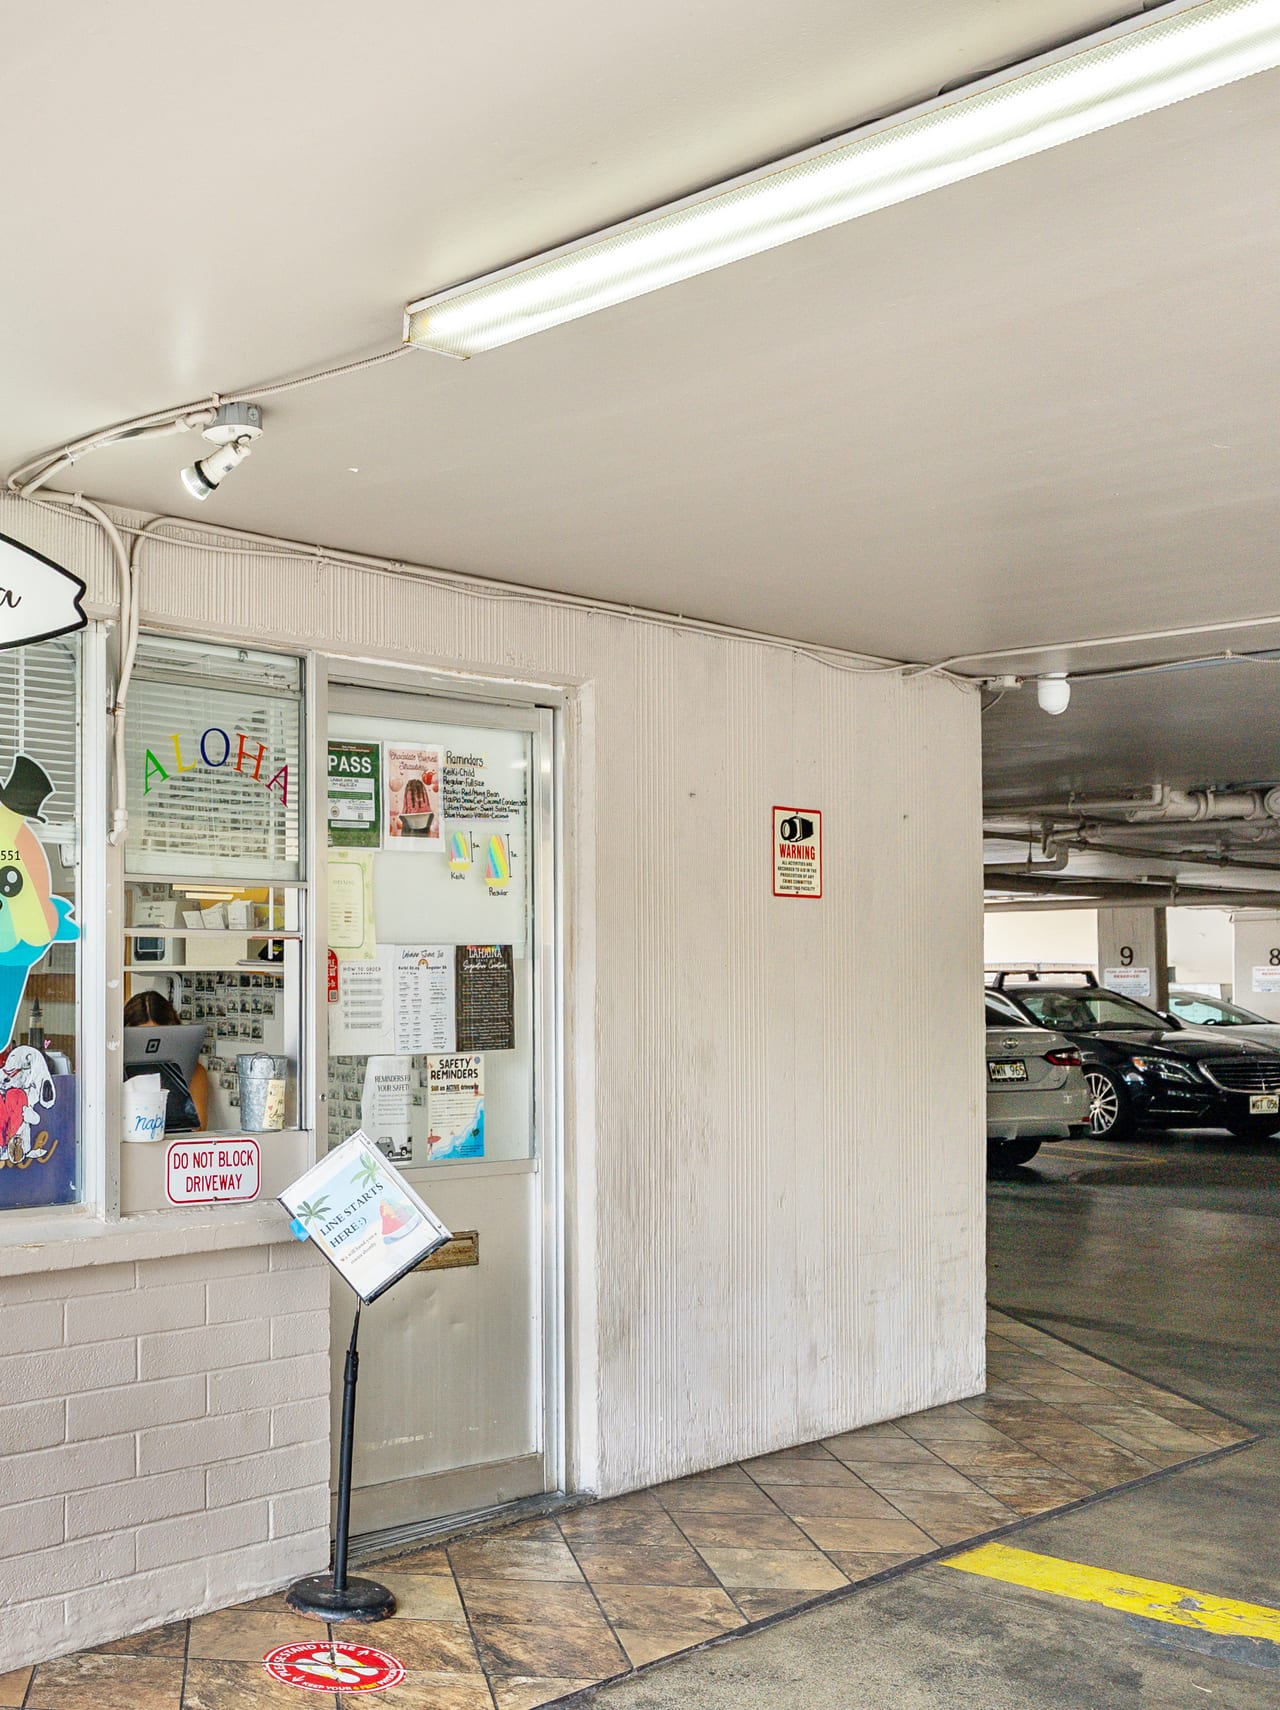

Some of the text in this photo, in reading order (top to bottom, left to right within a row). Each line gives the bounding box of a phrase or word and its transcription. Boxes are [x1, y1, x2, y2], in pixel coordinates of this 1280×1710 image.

[144, 727, 289, 808] ALOHA
[328, 755, 372, 774] PASS
[779, 843, 816, 860] WARNING
[469, 948, 502, 958] LAHAINA
[1120, 946, 1134, 967] 9
[1269, 948, 1280, 967] 8
[440, 1058, 471, 1069] SAFETY
[375, 1074, 404, 1083] REMINDERS
[431, 1069, 478, 1080] REMINDERS
[377, 1084, 392, 1093] YOUR
[173, 1150, 254, 1169] DO NOT BLOCK
[186, 1173, 243, 1193] DRIVEWAY
[320, 1182, 384, 1237] LINE STARTS
[330, 1223, 359, 1248] HERE
[273, 1643, 357, 1677] PLEASE STAND HERE
[302, 1681, 325, 1690] KEEP
